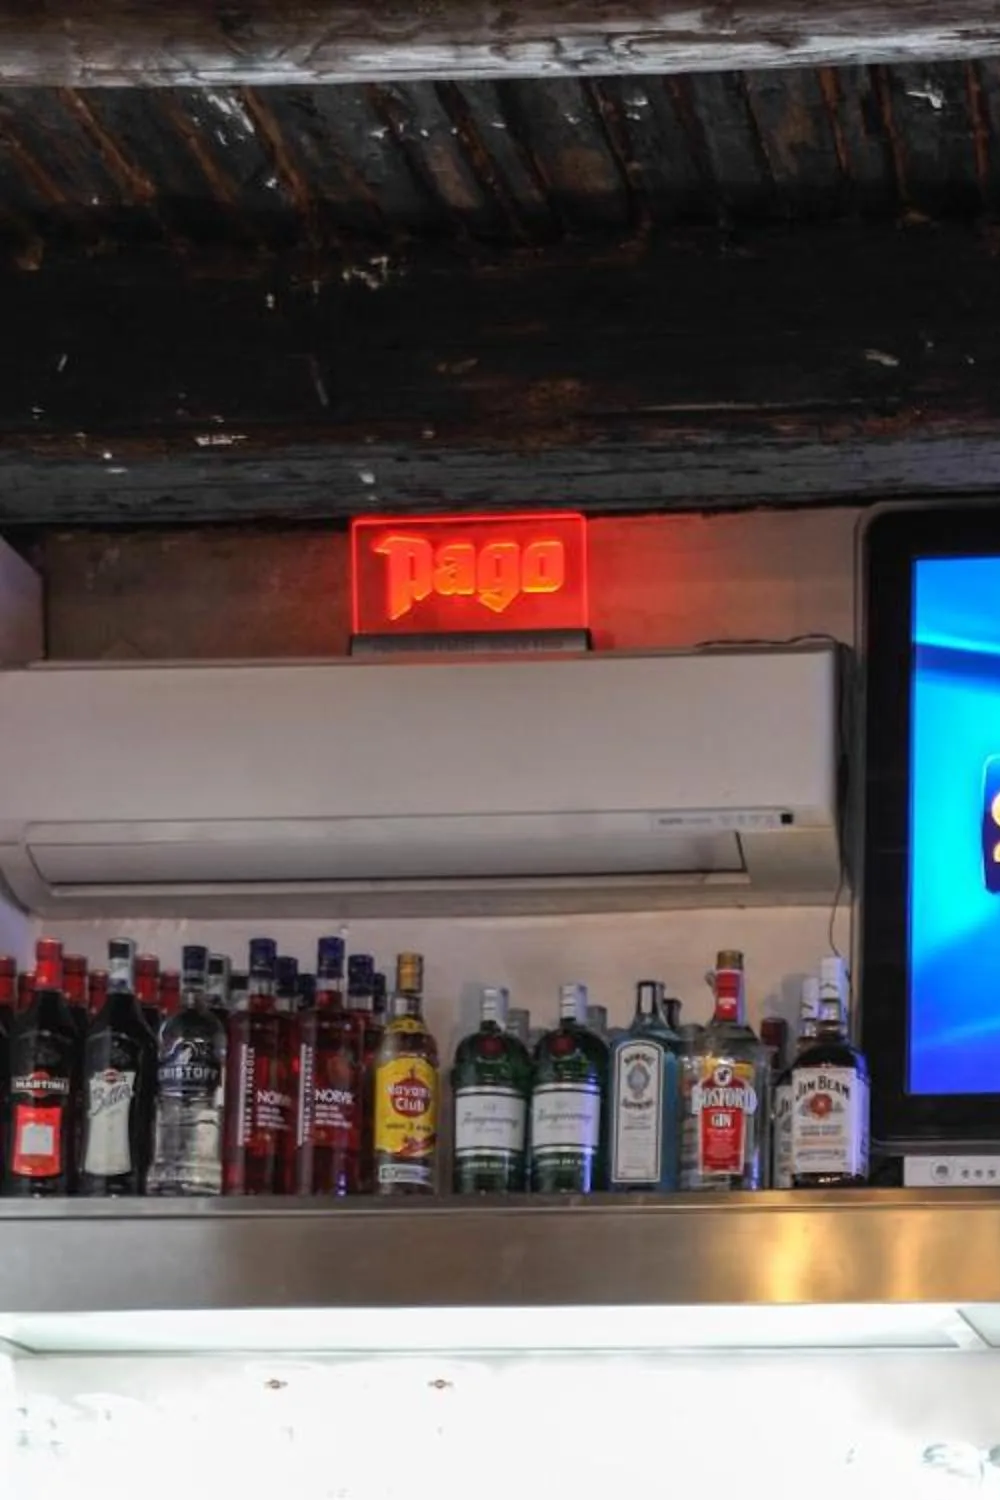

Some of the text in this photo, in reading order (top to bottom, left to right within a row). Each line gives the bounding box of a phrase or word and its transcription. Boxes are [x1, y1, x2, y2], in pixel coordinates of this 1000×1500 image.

[15, 1080, 65, 1091] MARTINI
[795, 1075, 850, 1100] JIM BEAM
[395, 1097, 425, 1112] Club
[711, 1113, 732, 1129] GIN
